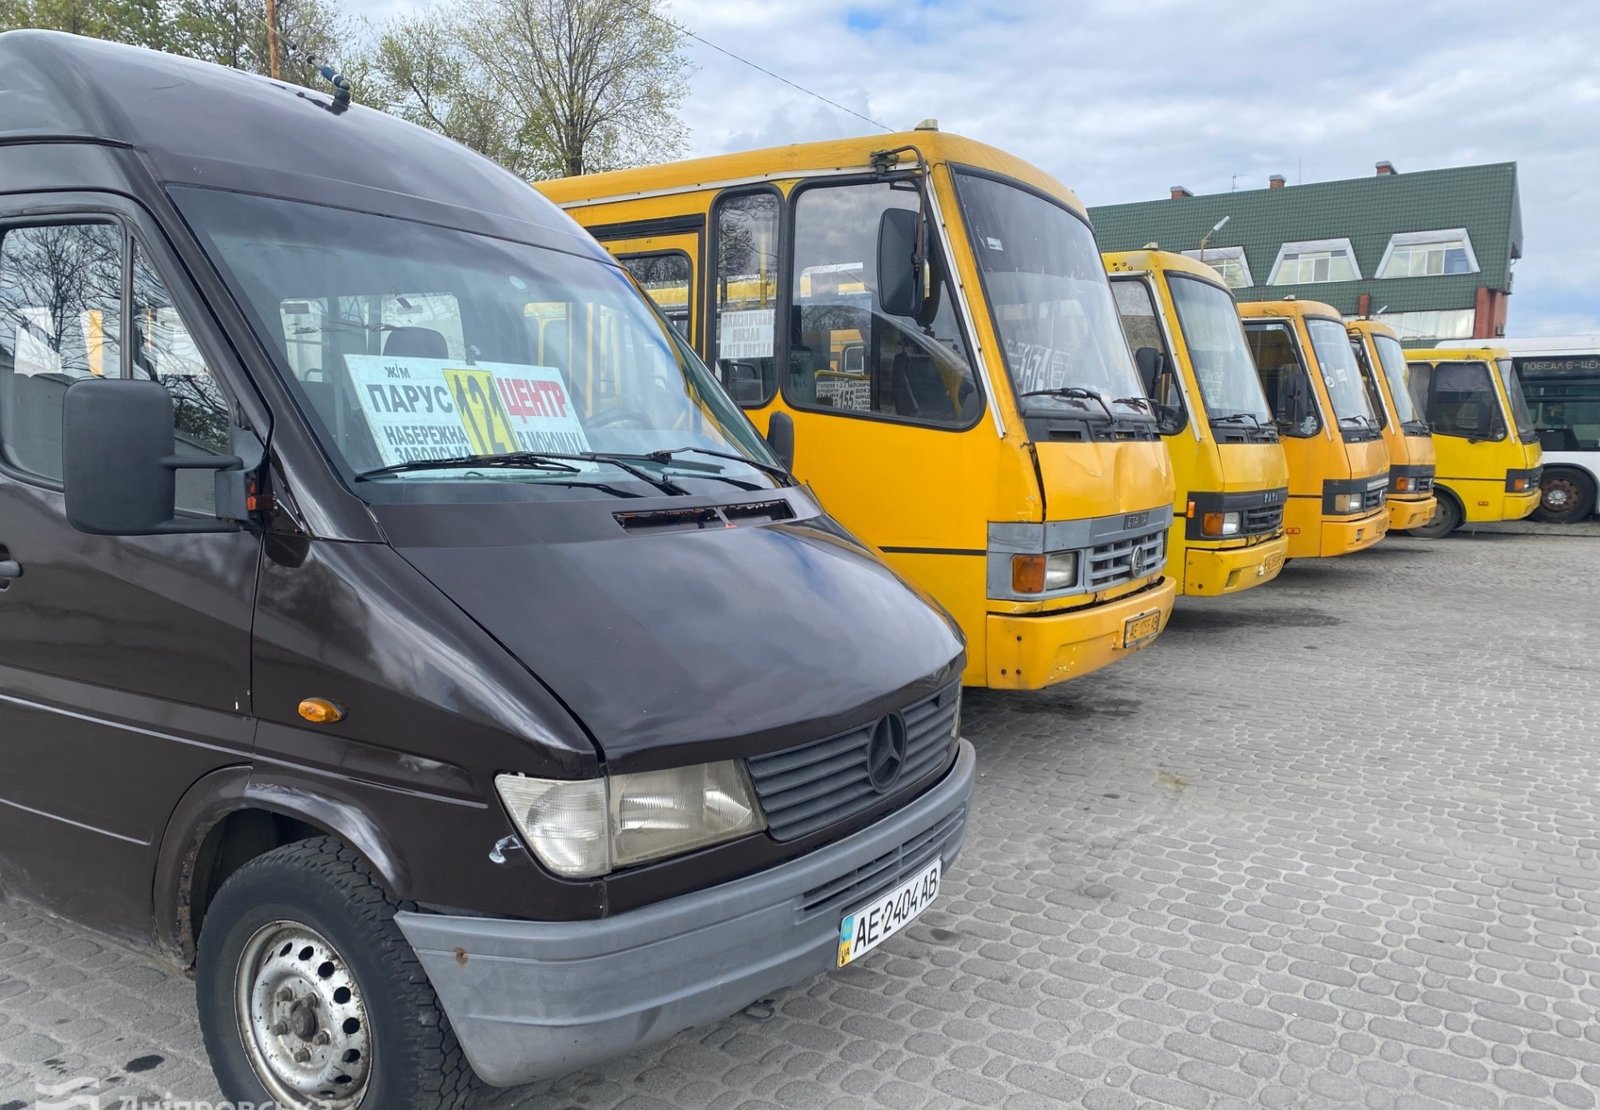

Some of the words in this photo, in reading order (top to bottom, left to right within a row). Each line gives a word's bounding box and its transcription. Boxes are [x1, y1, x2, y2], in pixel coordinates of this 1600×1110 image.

[366, 384, 453, 414] ПАРУС
[496, 377, 568, 424] ЦЕНТР
[840, 390, 854, 409] 155
[453, 374, 520, 455] 121
[382, 425, 470, 445] НАБЕРЕЖНА
